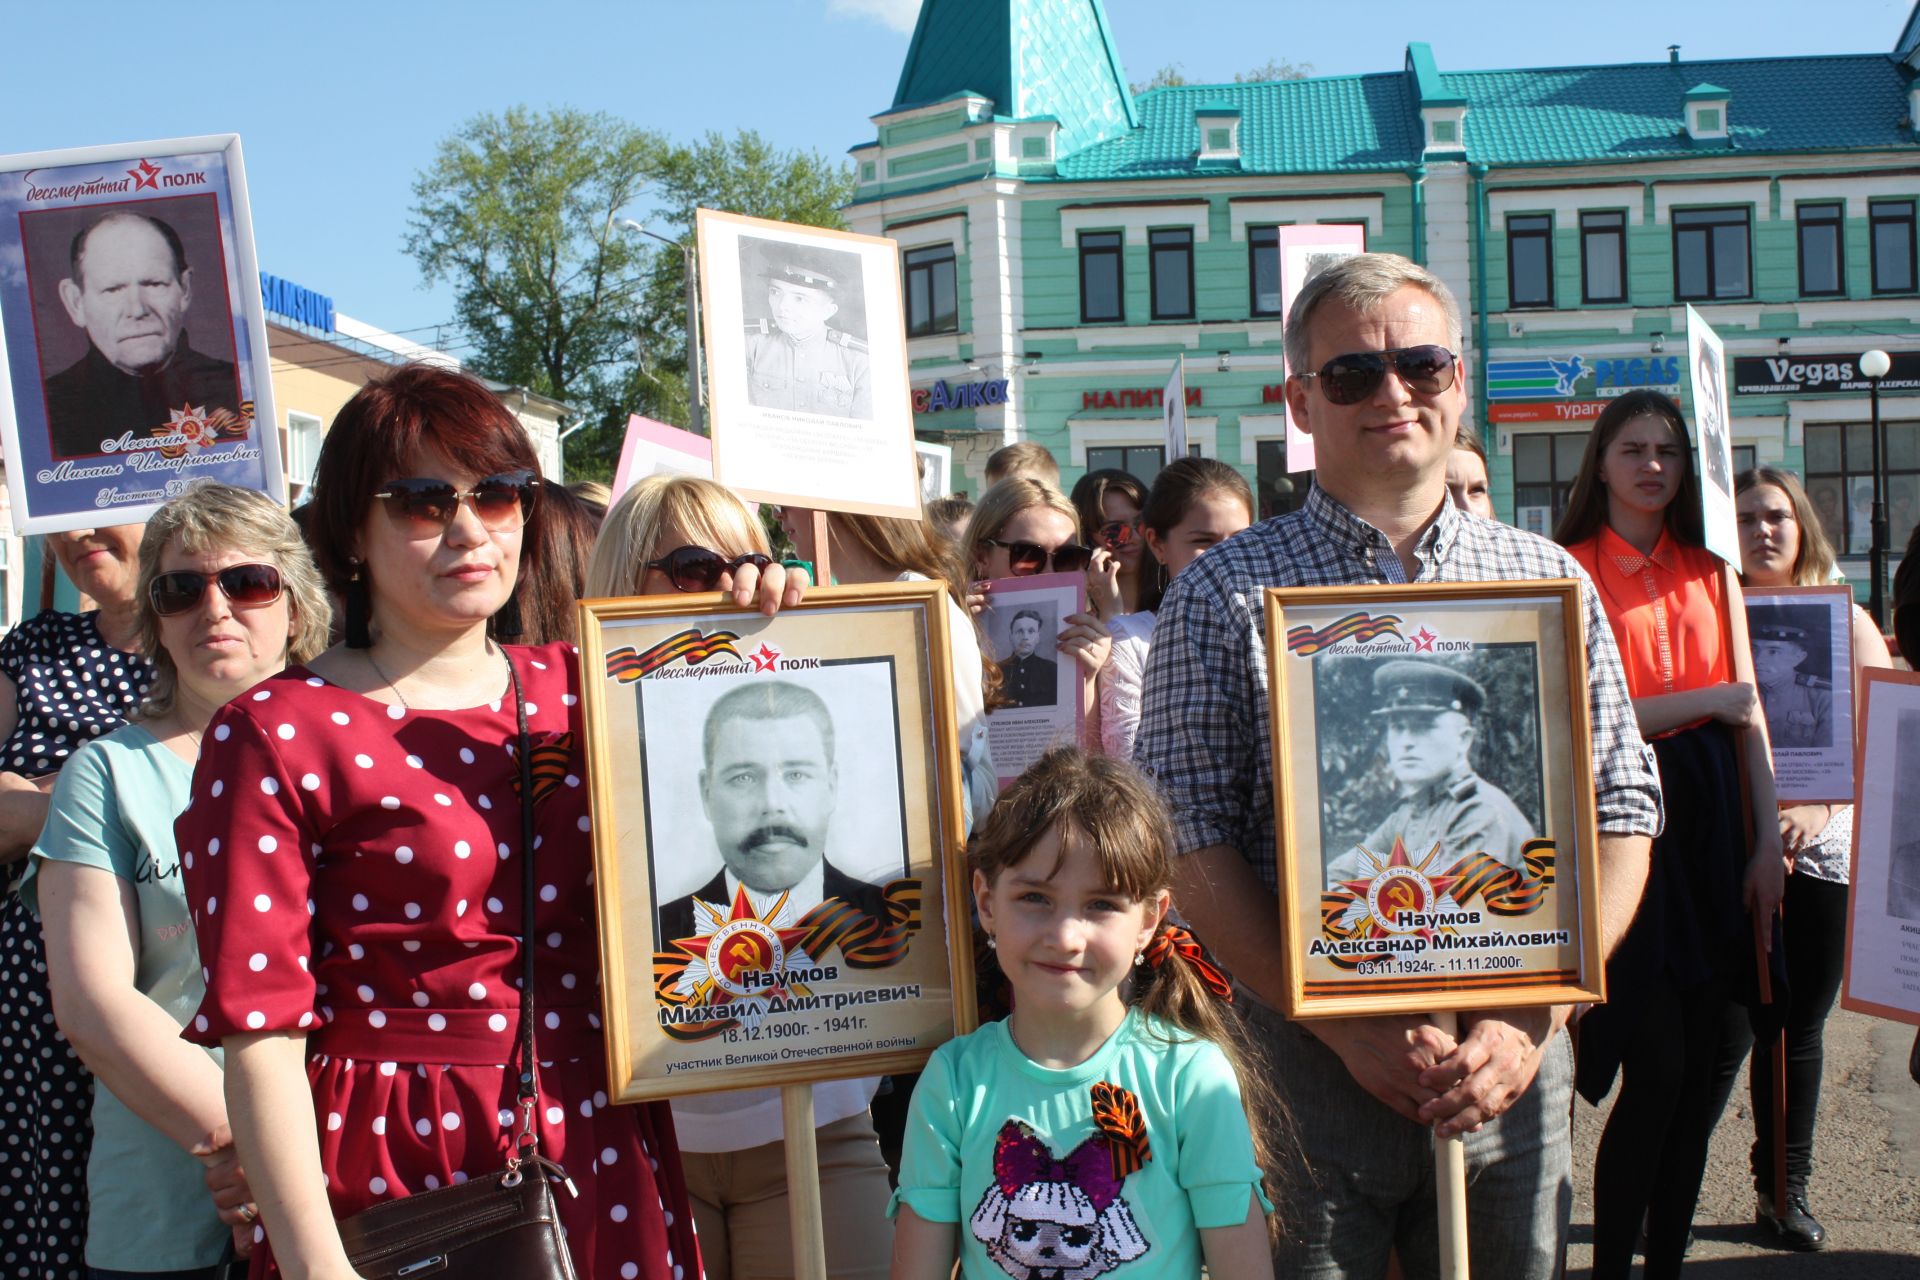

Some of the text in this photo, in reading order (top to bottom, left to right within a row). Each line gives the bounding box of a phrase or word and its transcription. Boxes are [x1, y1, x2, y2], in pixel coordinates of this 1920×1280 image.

[163, 172, 207, 187] ПОЛК
[259, 271, 335, 333] SAMSUNG
[1596, 356, 1681, 388] PEGAS
[1765, 358, 1854, 386] Vegas
[1840, 379, 1920, 390] ПАРИКАХЕРСКА
[1083, 387, 1202, 410] НАПИТИ
[37, 444, 261, 484] Михаил Илларионович
[96, 486, 164, 507] Участник
[1437, 641, 1472, 651] ПОЛК
[655, 658, 820, 681] бессмертный ПОЛК
[1398, 911, 1481, 929] Наумов
[1309, 930, 1568, 956] Александр Михайлович
[1357, 960, 1437, 975] 03.11.1924г.
[1448, 956, 1524, 971] 11.11.2000г.
[742, 966, 839, 989] Наумов
[660, 984, 922, 1026] Михаил Дмитриевич
[719, 1022, 810, 1044] 18.12.1900г.
[825, 1015, 868, 1034] 1941г.
[666, 1035, 917, 1074] участник Великой Отечественной войны
